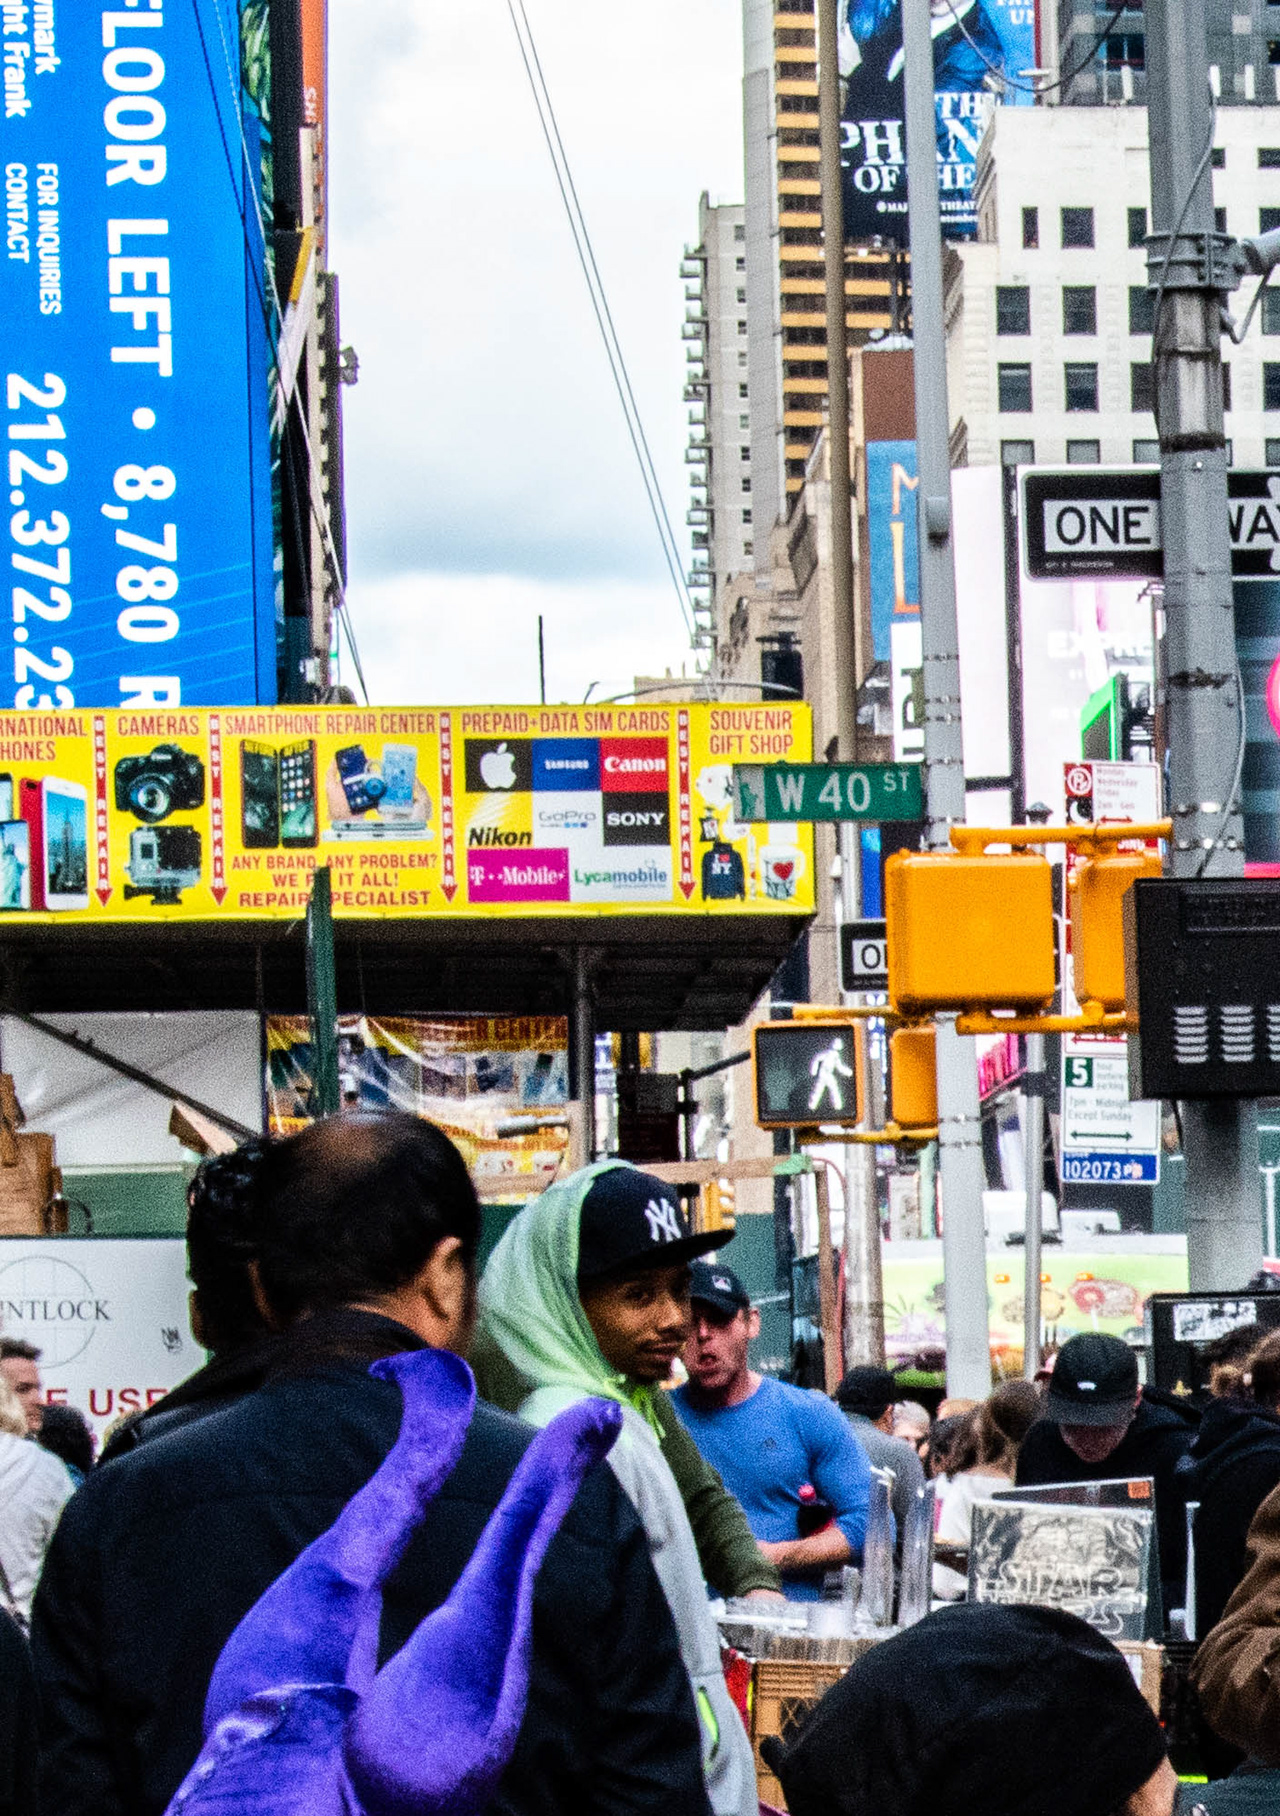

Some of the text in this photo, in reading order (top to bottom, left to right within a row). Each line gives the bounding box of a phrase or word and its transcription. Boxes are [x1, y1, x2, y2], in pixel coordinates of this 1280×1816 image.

[3, 42, 32, 118] Frank
[101, 0, 167, 187] LOOR
[854, 164, 976, 192] OF HE
[5, 162, 29, 263] CONTACT
[36, 163, 62, 315] FOR INQUIRIES
[106, 218, 173, 378] LEFT
[1055, 505, 1150, 546] ONE
[101, 463, 180, 644] 8,780
[117, 715, 200, 737] CAMERAS
[225, 711, 436, 736] SMARTPHONE REPAIR CENTER
[584, 711, 613, 732] SIM
[617, 710, 670, 732] CARDS
[709, 710, 793, 731] SOUVENIR
[709, 733, 794, 755] GIFT SHOP
[604, 756, 667, 773] Canon
[776, 771, 910, 813] W 40 ST
[538, 810, 597, 823] GoPro
[606, 811, 665, 827] SONY
[469, 827, 532, 847] Nikon
[232, 855, 261, 870] ANY
[325, 854, 354, 869] ANY
[359, 853, 438, 869] PROBLEM?
[272, 874, 298, 888] WE
[339, 873, 399, 887] IT ALL!
[573, 866, 668, 887] Lycamobile
[239, 890, 431, 907] REPAIR PECIALIST
[1071, 1058, 1089, 1086] 5
[1065, 1160, 1122, 1179] 102073
[0, 1299, 112, 1322] NTLOCK
